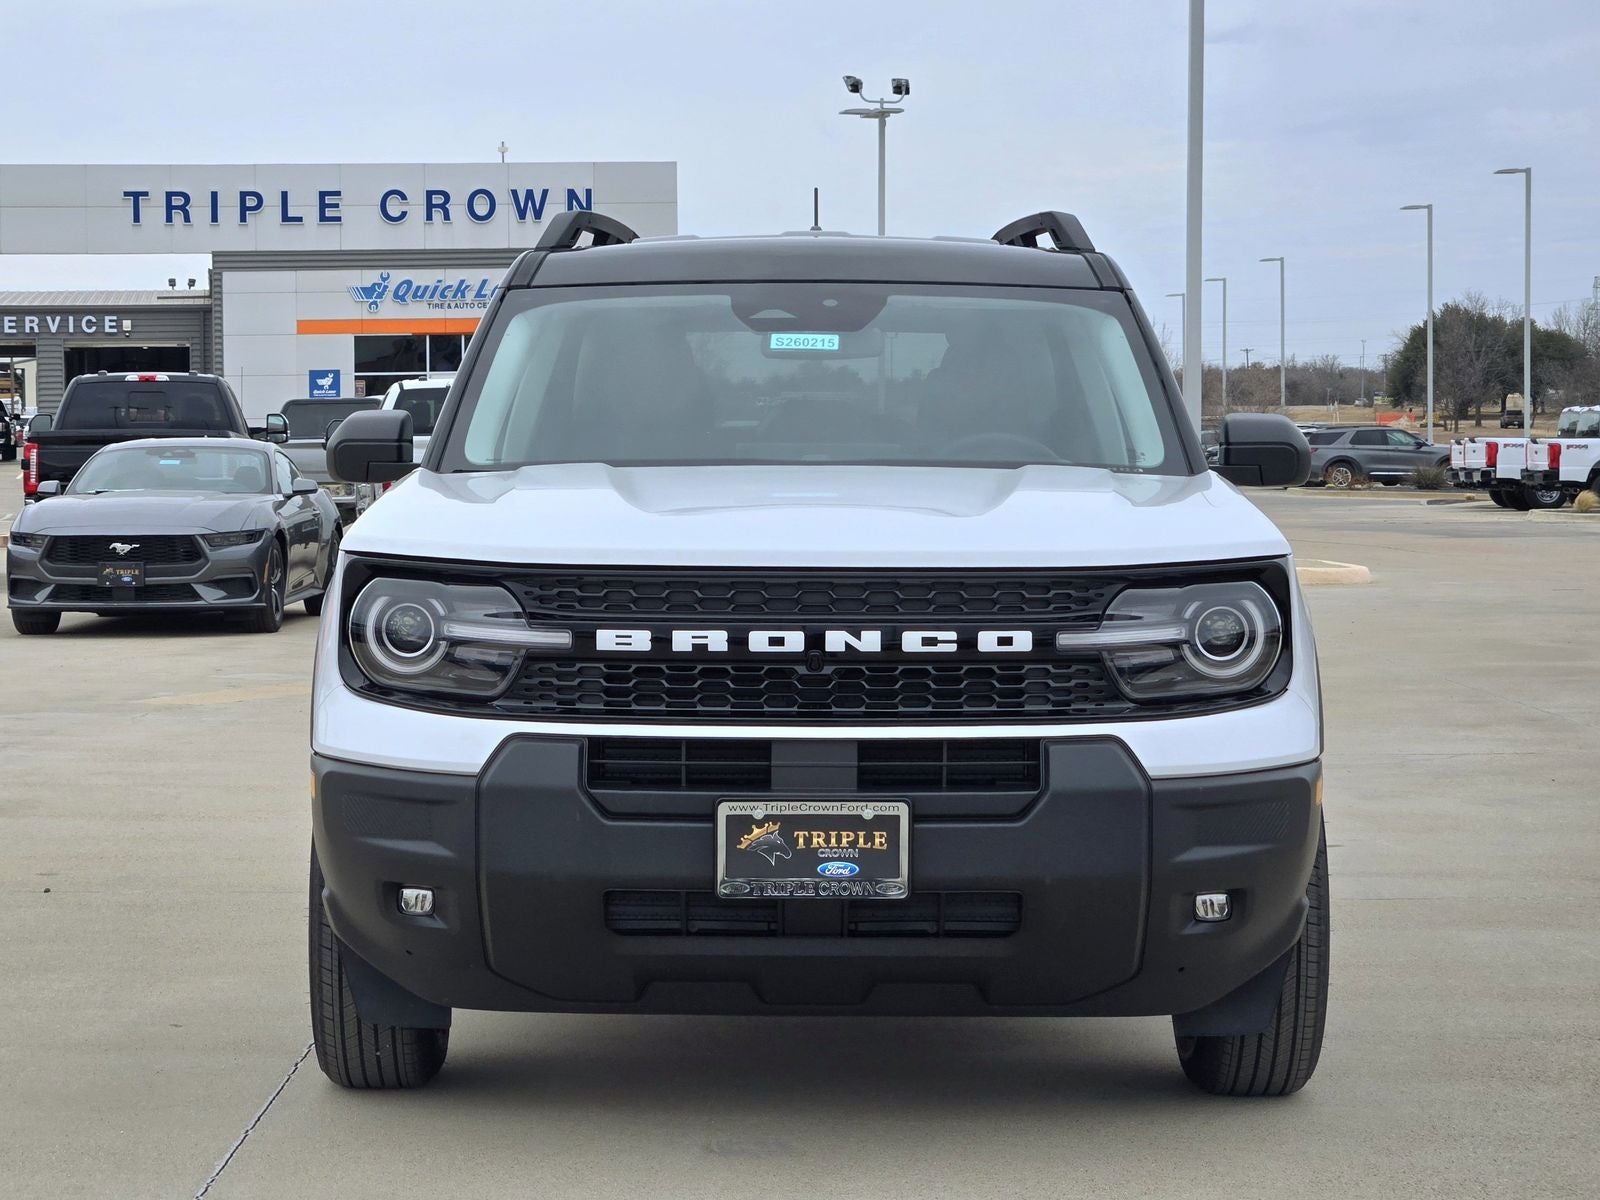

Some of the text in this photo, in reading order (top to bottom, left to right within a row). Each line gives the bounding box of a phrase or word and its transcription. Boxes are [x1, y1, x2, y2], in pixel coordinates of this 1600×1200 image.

[123, 188, 593, 225] TRIPLE CROWN
[392, 279, 471, 305] Quick
[427, 302, 446, 310] TIRE
[447, 302, 453, 310] &
[453, 302, 475, 310] AUTO
[775, 337, 836, 348] S260215
[595, 629, 1033, 653] BRONCO
[794, 831, 888, 849] TRIPLE
[817, 848, 859, 858] CROWN
[750, 881, 816, 896] TRIPLE
[818, 881, 876, 896] CROWN
